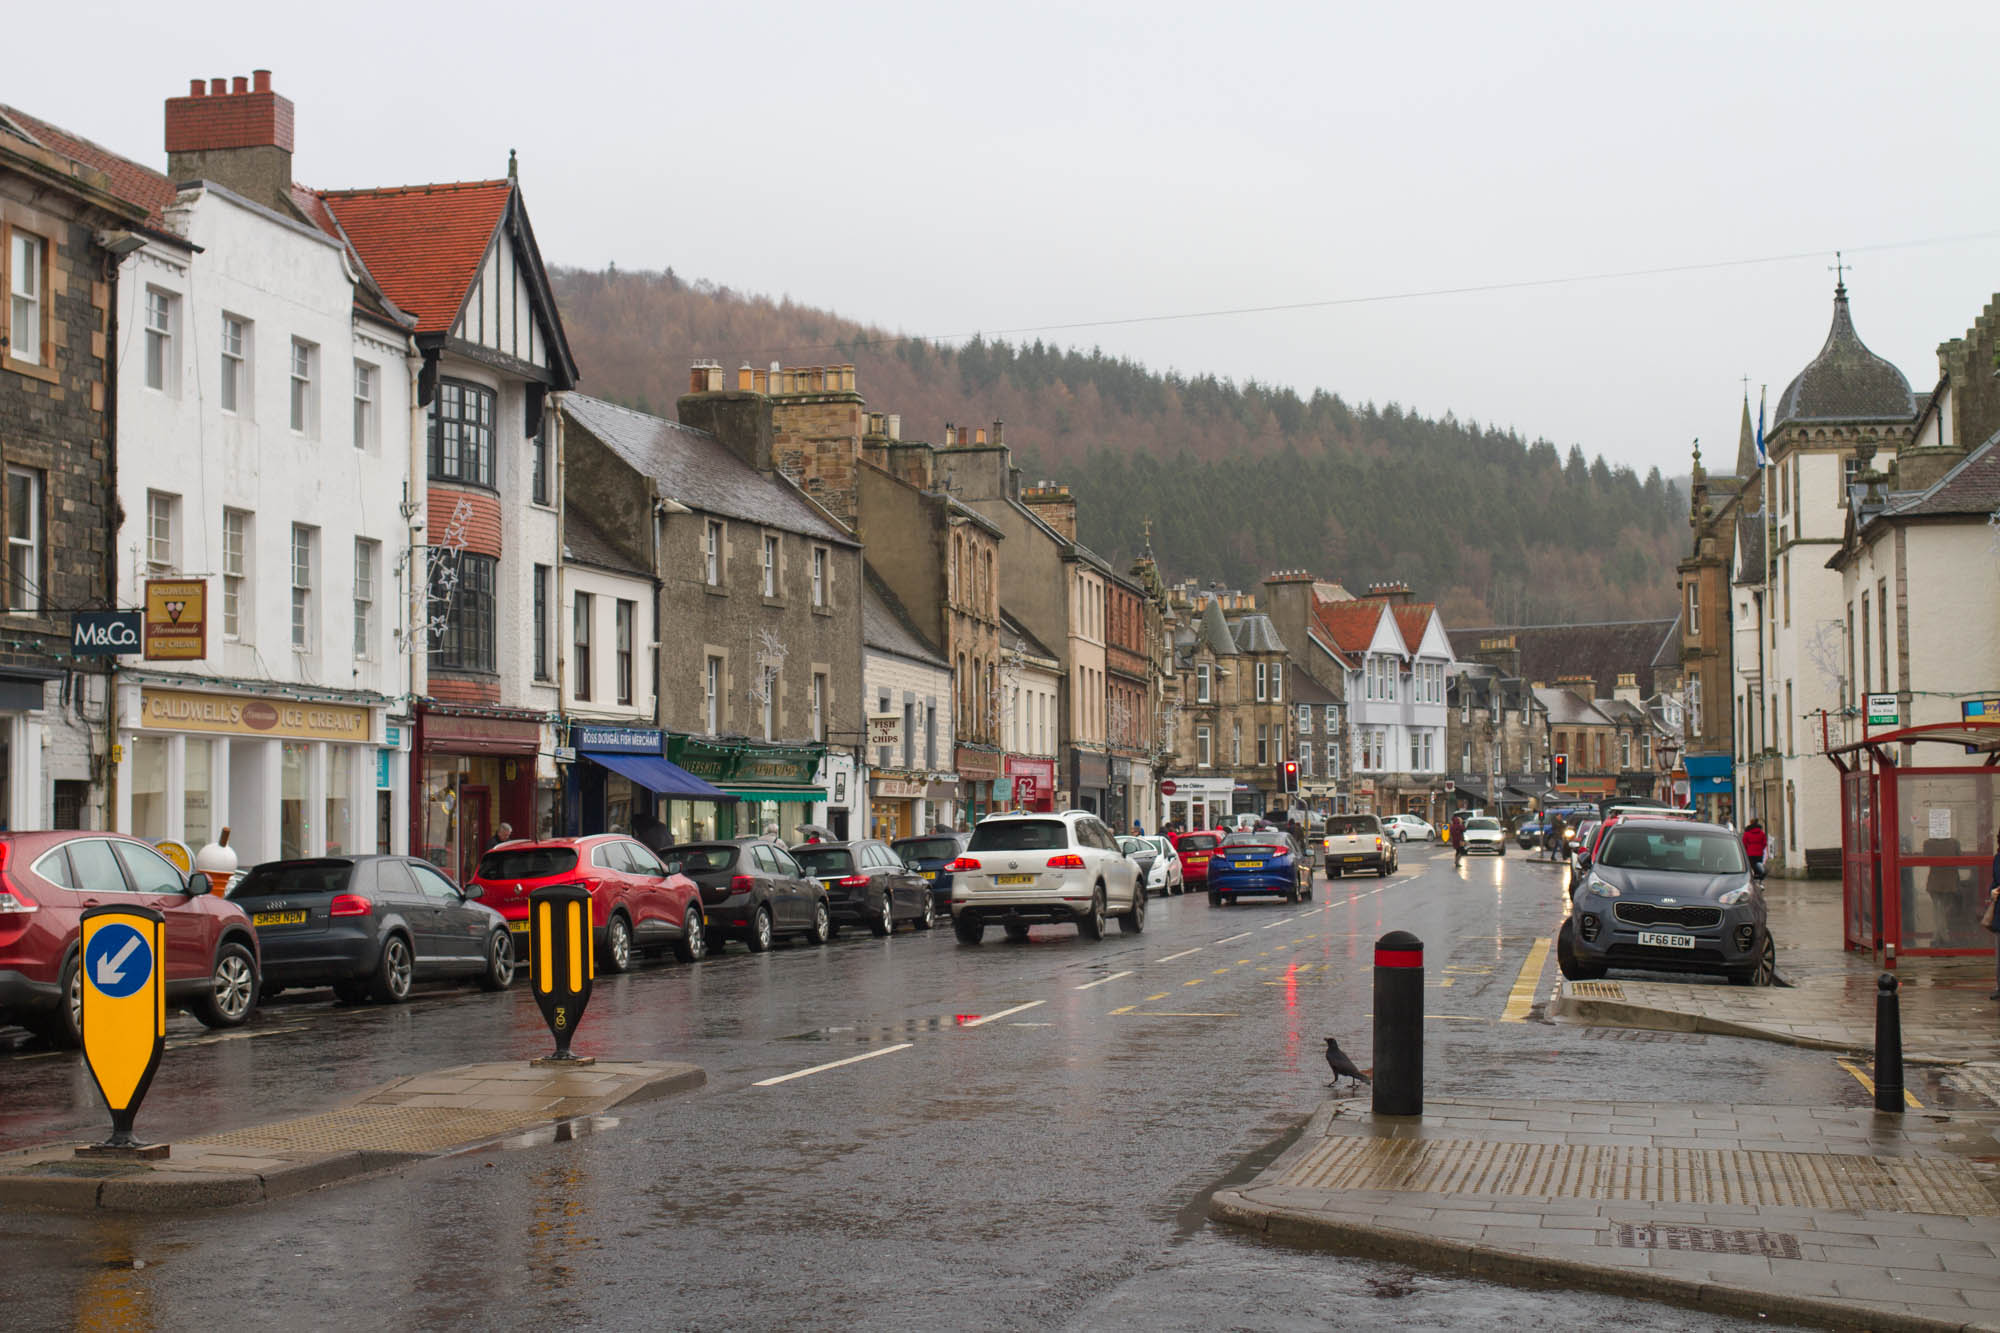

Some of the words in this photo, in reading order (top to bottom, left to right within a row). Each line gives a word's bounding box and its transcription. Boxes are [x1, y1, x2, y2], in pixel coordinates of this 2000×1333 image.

[74, 621, 138, 647] M&Co.
[150, 696, 241, 724] CALDWELL'S
[280, 710, 304, 727] ICE
[307, 711, 354, 731] CREAM
[874, 720, 896, 729] FISH
[583, 731, 597, 744] ROSS
[598, 732, 620, 745] DOUGAL
[620, 733, 632, 746] FISH
[632, 734, 659, 747] MERCHANT
[872, 735, 899, 743] CHIPS
[1642, 933, 1669, 945] LF66
[1671, 936, 1691, 947] EOW
